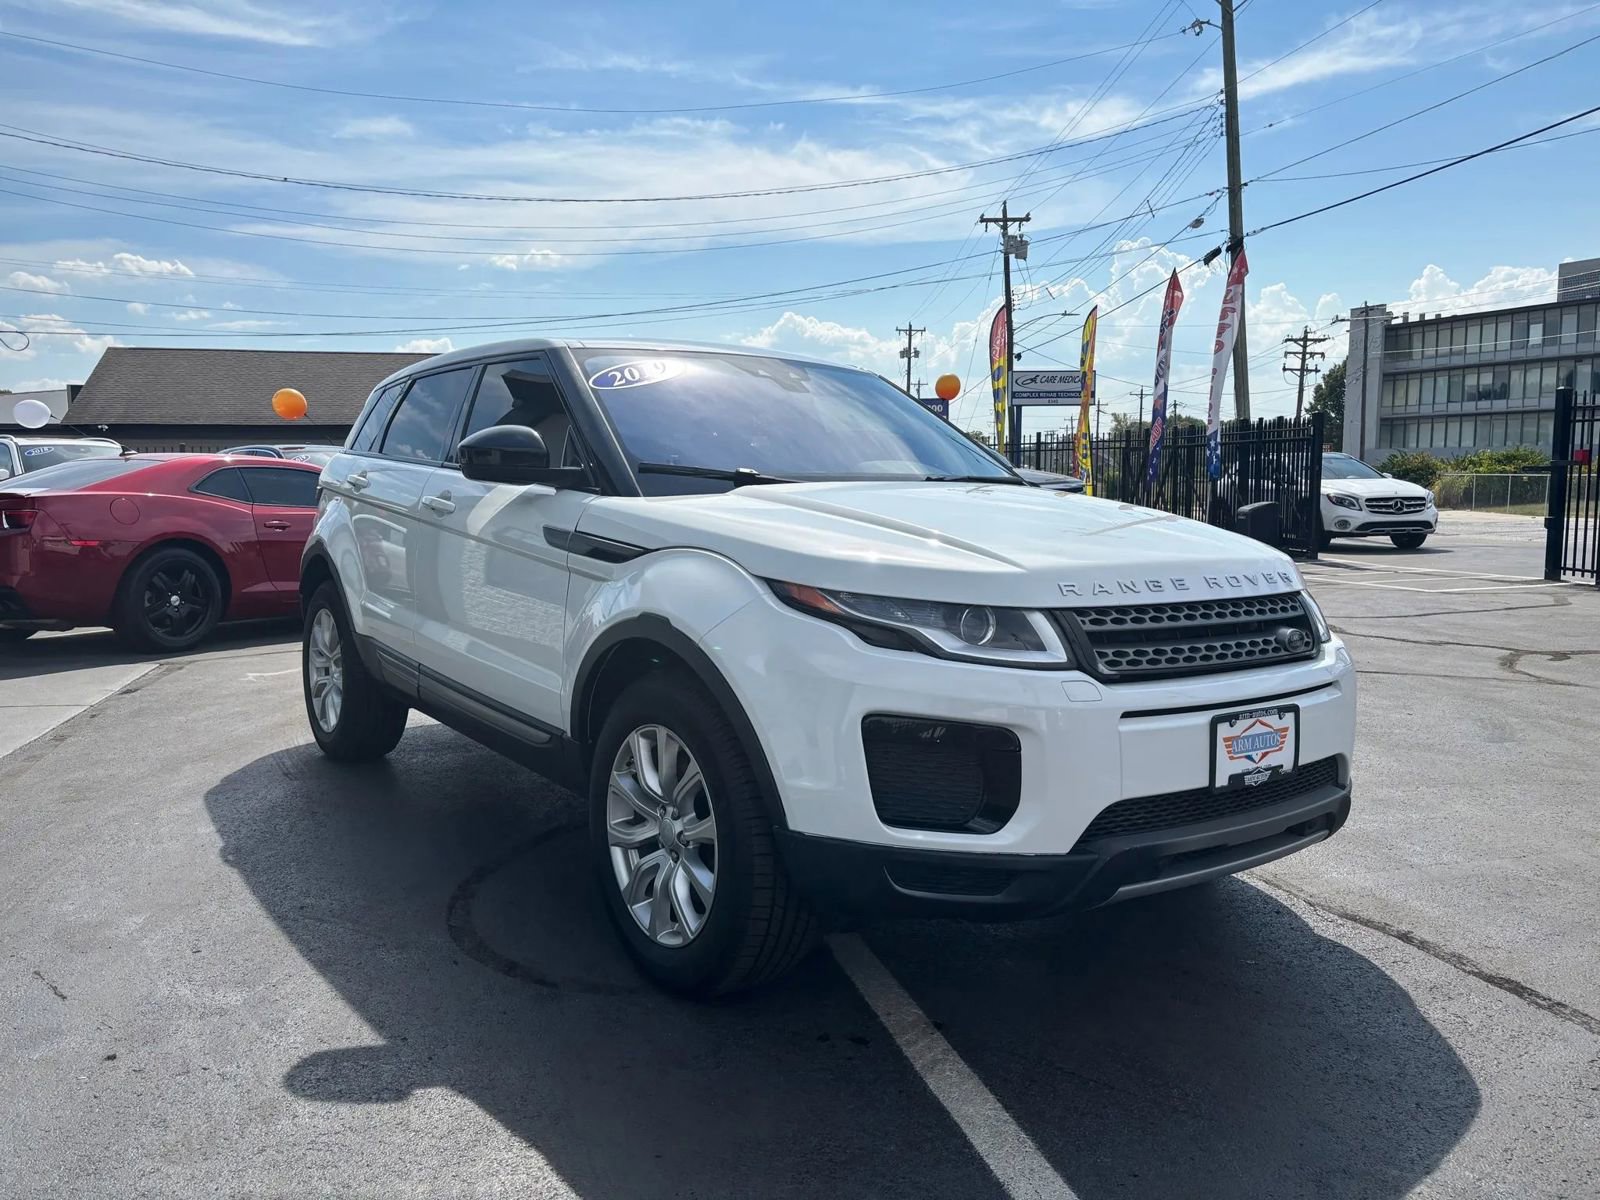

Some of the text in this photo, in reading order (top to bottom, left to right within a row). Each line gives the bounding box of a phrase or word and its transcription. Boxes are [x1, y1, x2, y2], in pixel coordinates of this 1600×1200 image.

[607, 361, 667, 386] 209
[1039, 375, 1081, 384] CARE MEDIC
[1057, 571, 1294, 597] RANGE ROVER
[1232, 732, 1281, 753] ARM AUTOS
